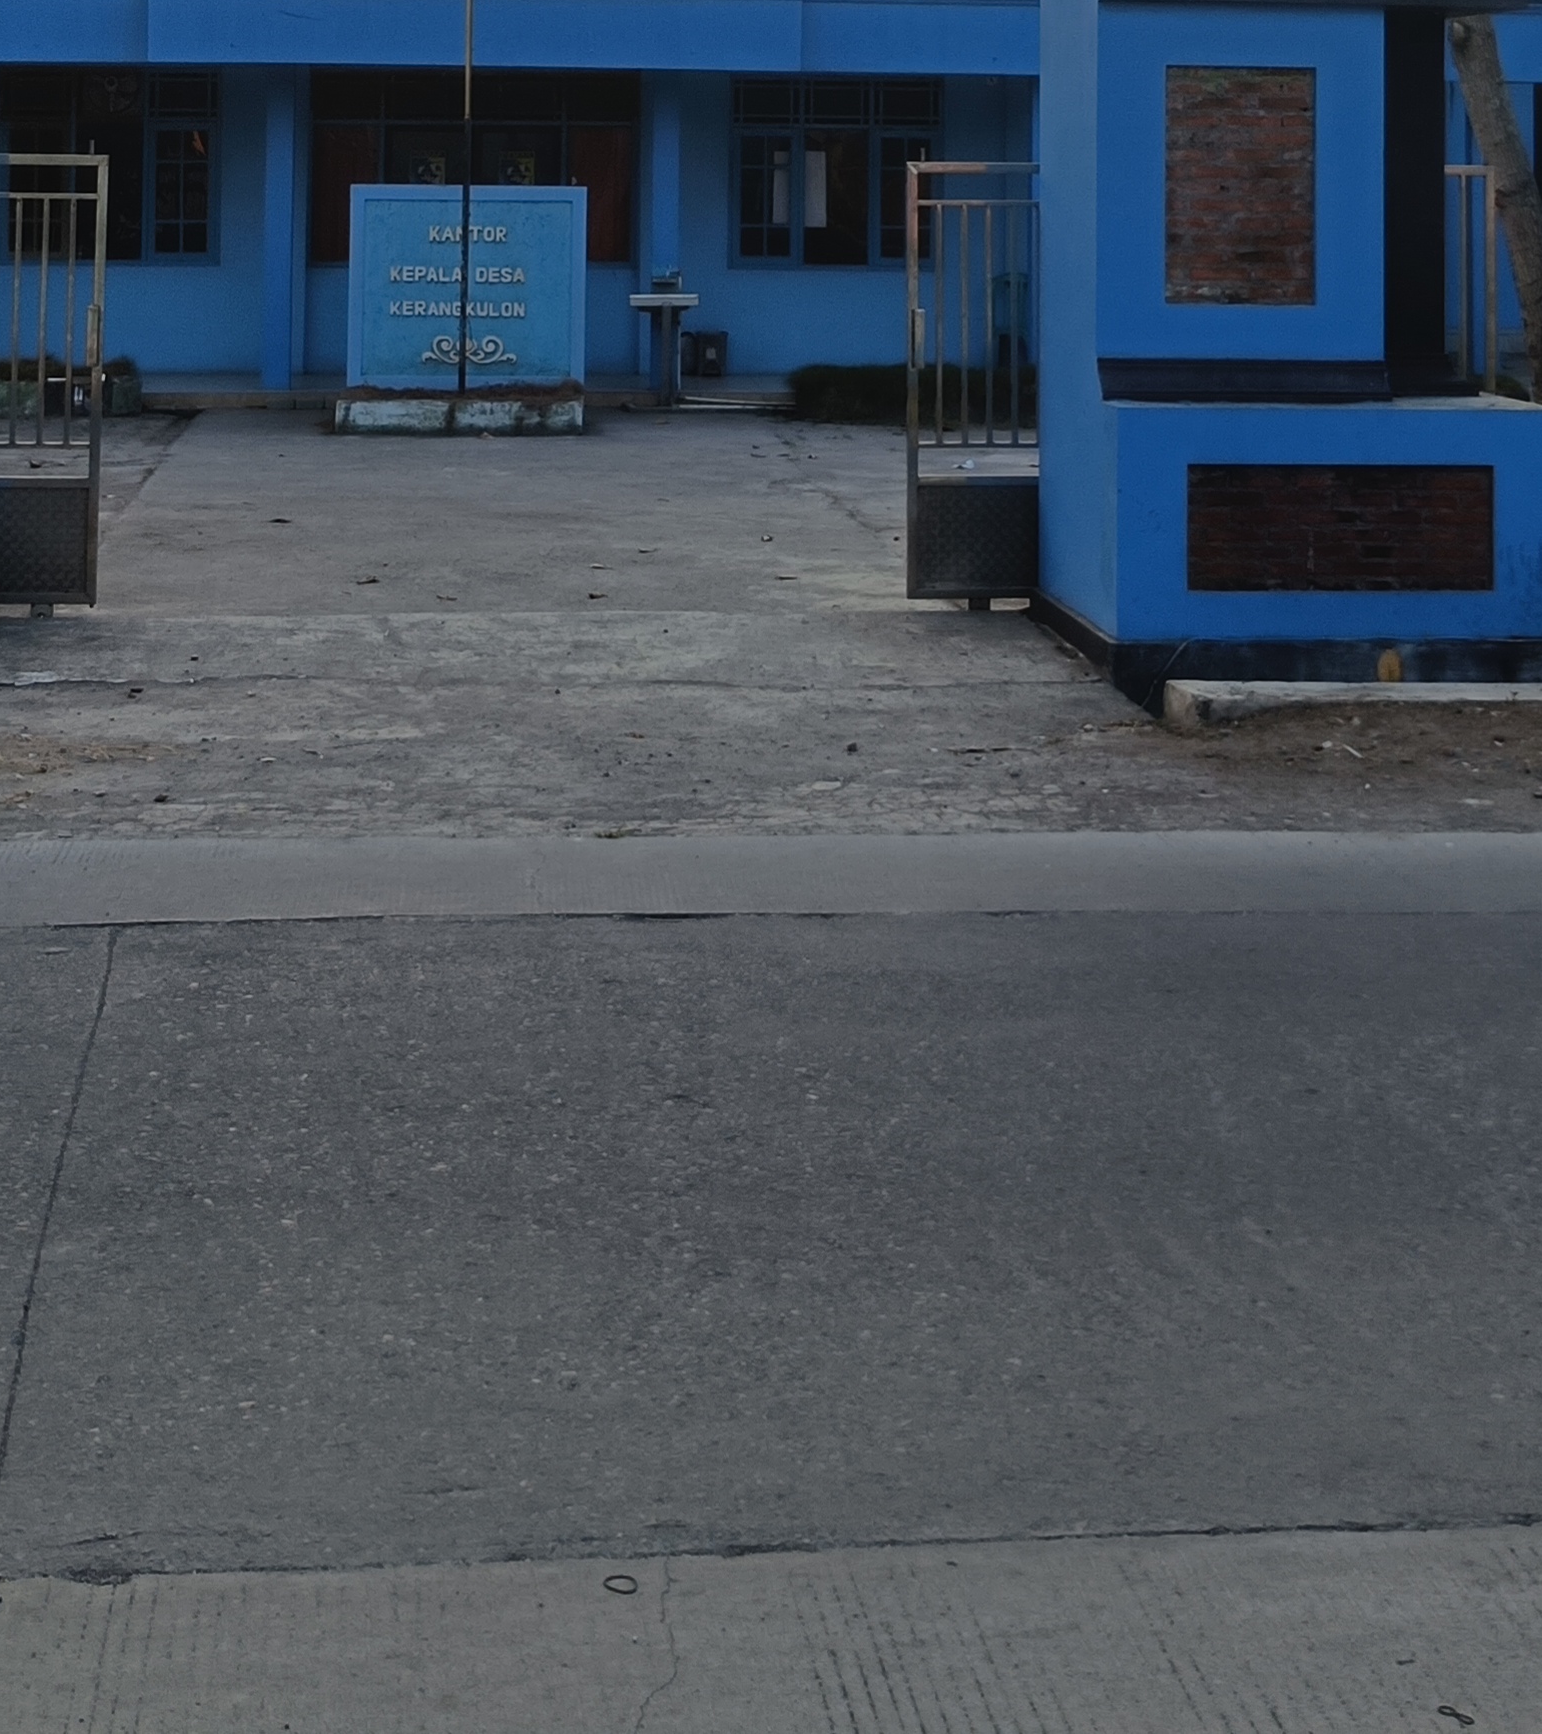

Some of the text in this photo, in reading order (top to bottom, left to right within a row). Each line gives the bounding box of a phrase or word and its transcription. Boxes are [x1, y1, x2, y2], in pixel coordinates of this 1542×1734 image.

[390, 266, 526, 283] KEPALA DESA
[389, 300, 526, 317] KERANGKULON
